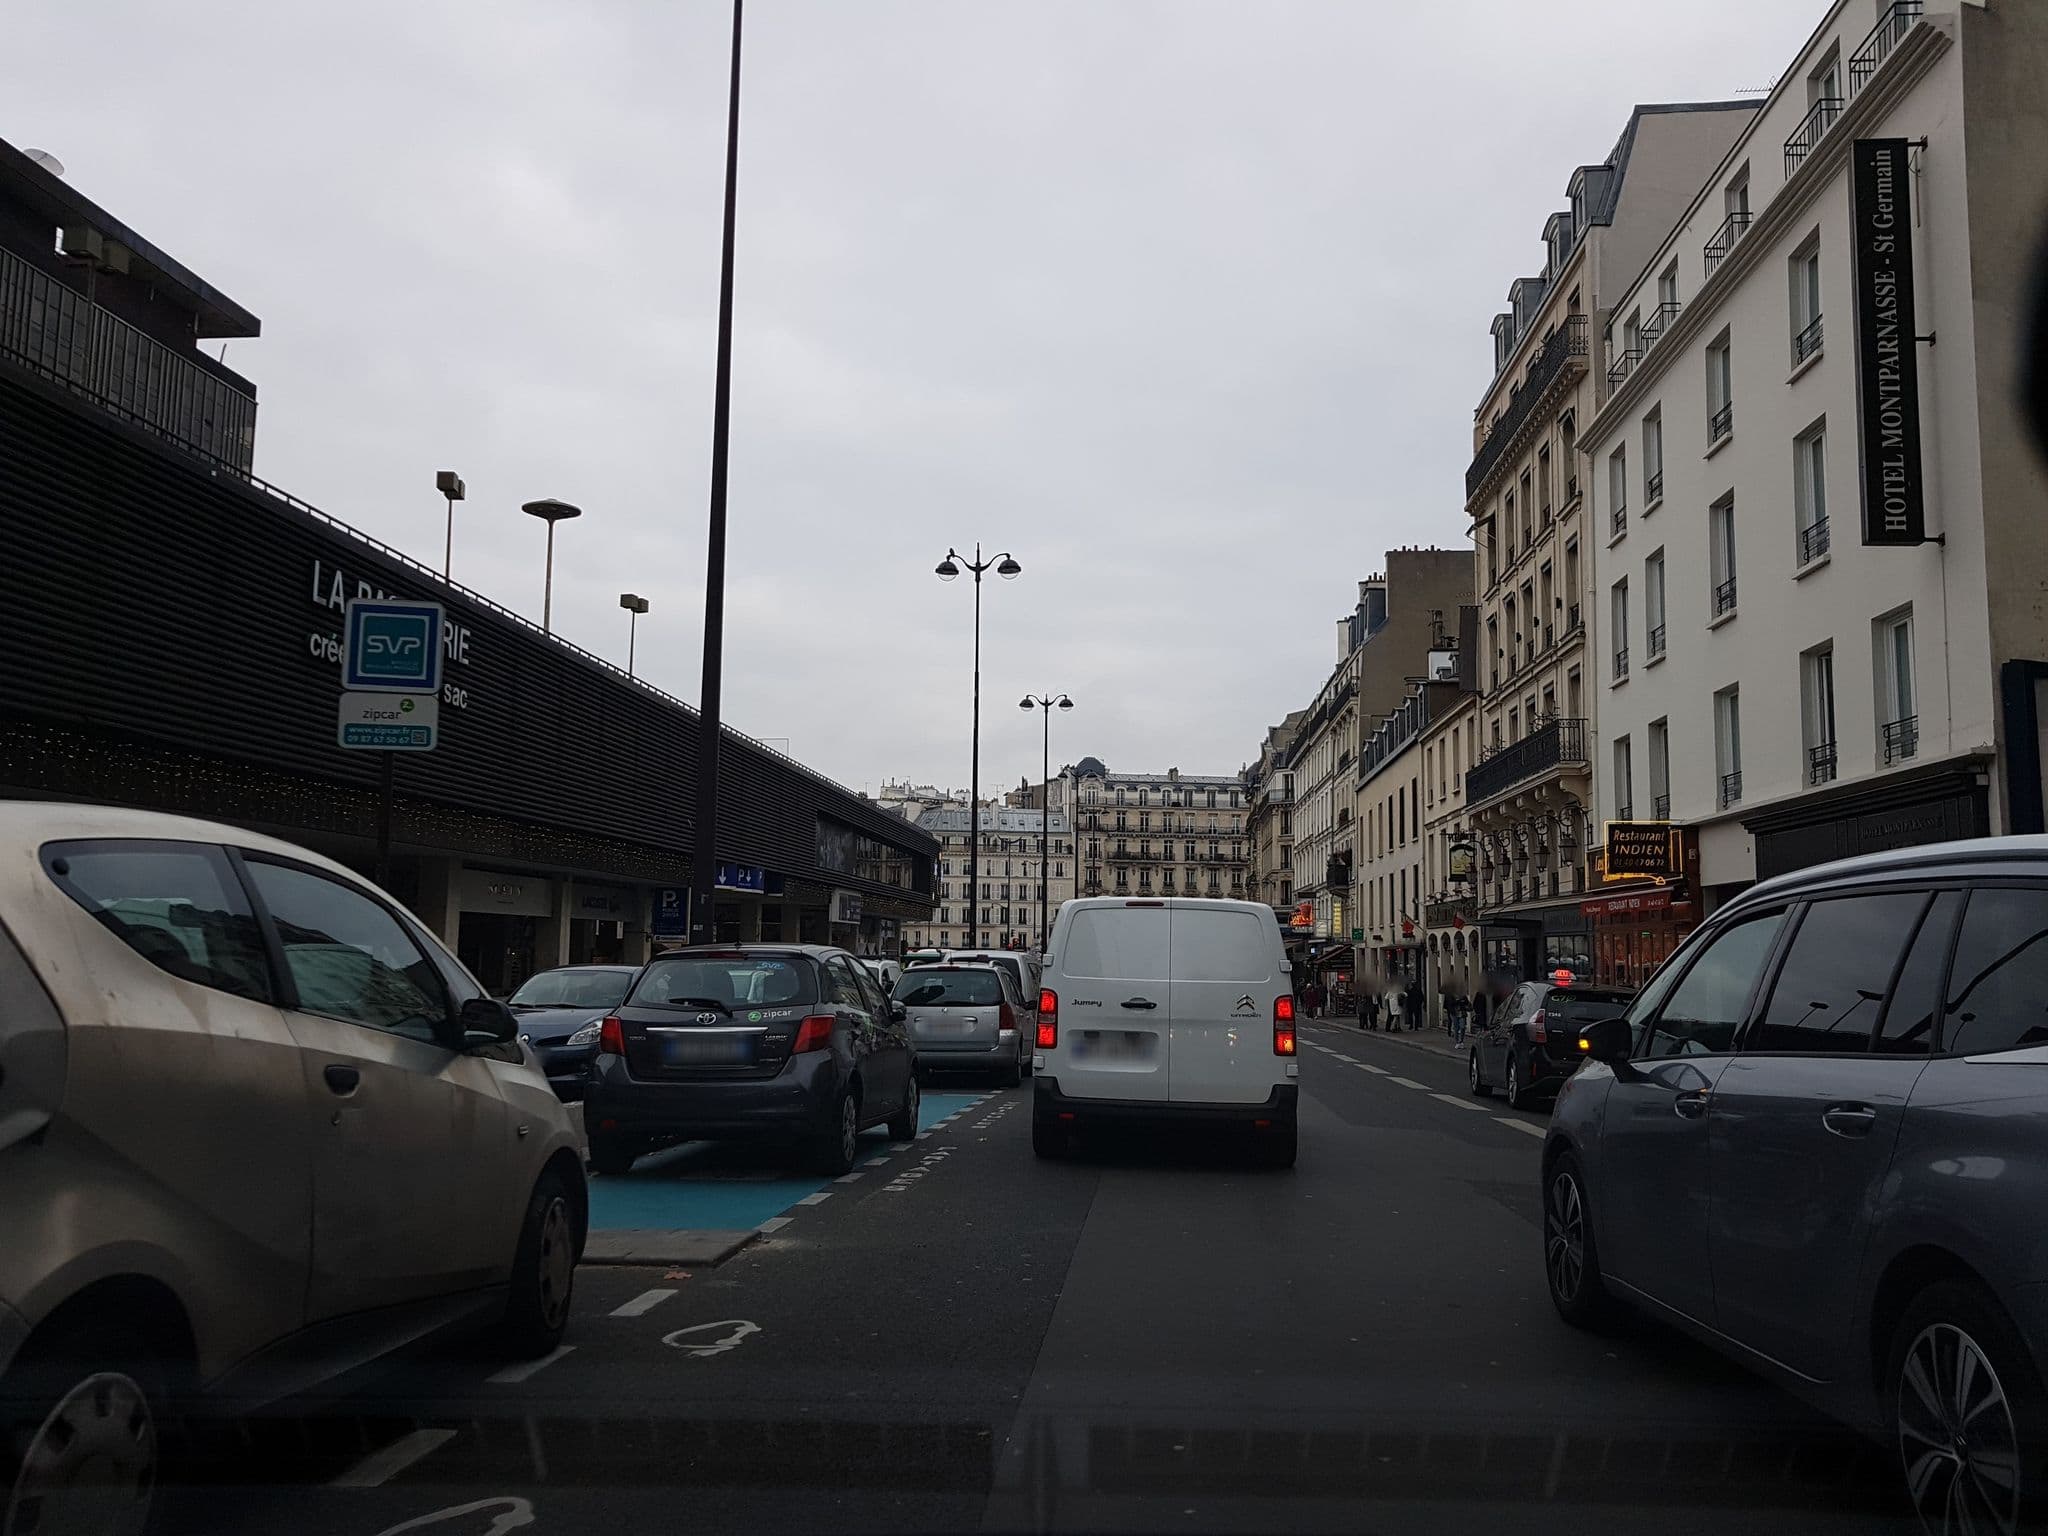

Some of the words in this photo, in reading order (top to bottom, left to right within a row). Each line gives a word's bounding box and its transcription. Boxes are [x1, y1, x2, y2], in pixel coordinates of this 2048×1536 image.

[1871, 149, 1896, 229] Germain
[1873, 232, 1896, 253] St
[1874, 270, 1904, 448] MONTPARNASSE
[1883, 454, 1907, 532] HOTEL
[366, 634, 422, 656] SVP
[362, 708, 402, 721] zipcar
[1613, 828, 1666, 842] Restaurant
[1614, 843, 1666, 856] INDIEN
[762, 1008, 793, 1019] zipcar
